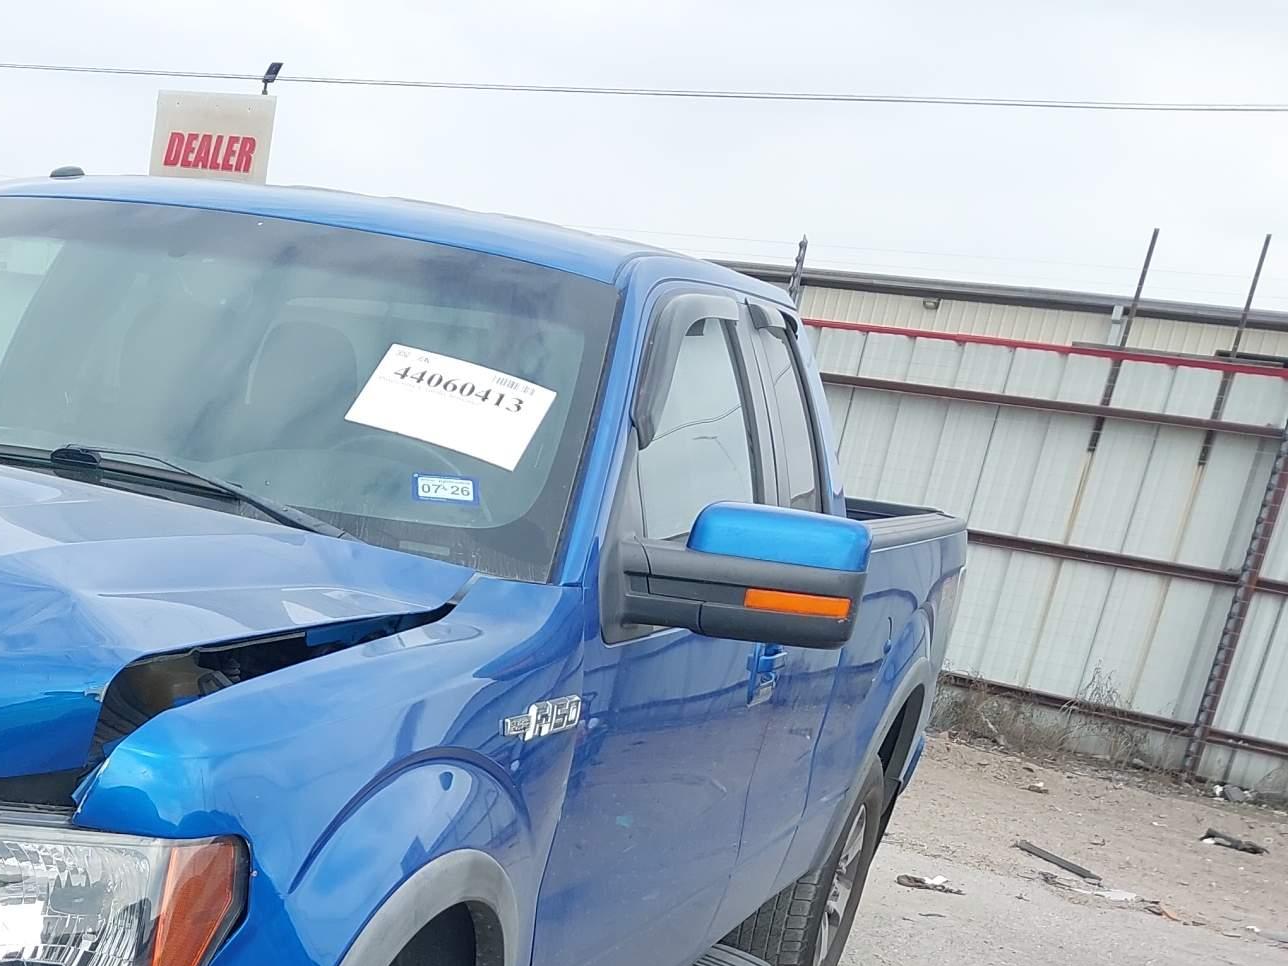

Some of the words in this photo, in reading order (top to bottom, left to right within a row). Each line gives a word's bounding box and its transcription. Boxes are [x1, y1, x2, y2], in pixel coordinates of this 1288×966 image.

[163, 131, 256, 173] DEALER
[393, 366, 524, 413] 44060413
[421, 483, 441, 494] 07
[450, 485, 471, 497] 26
